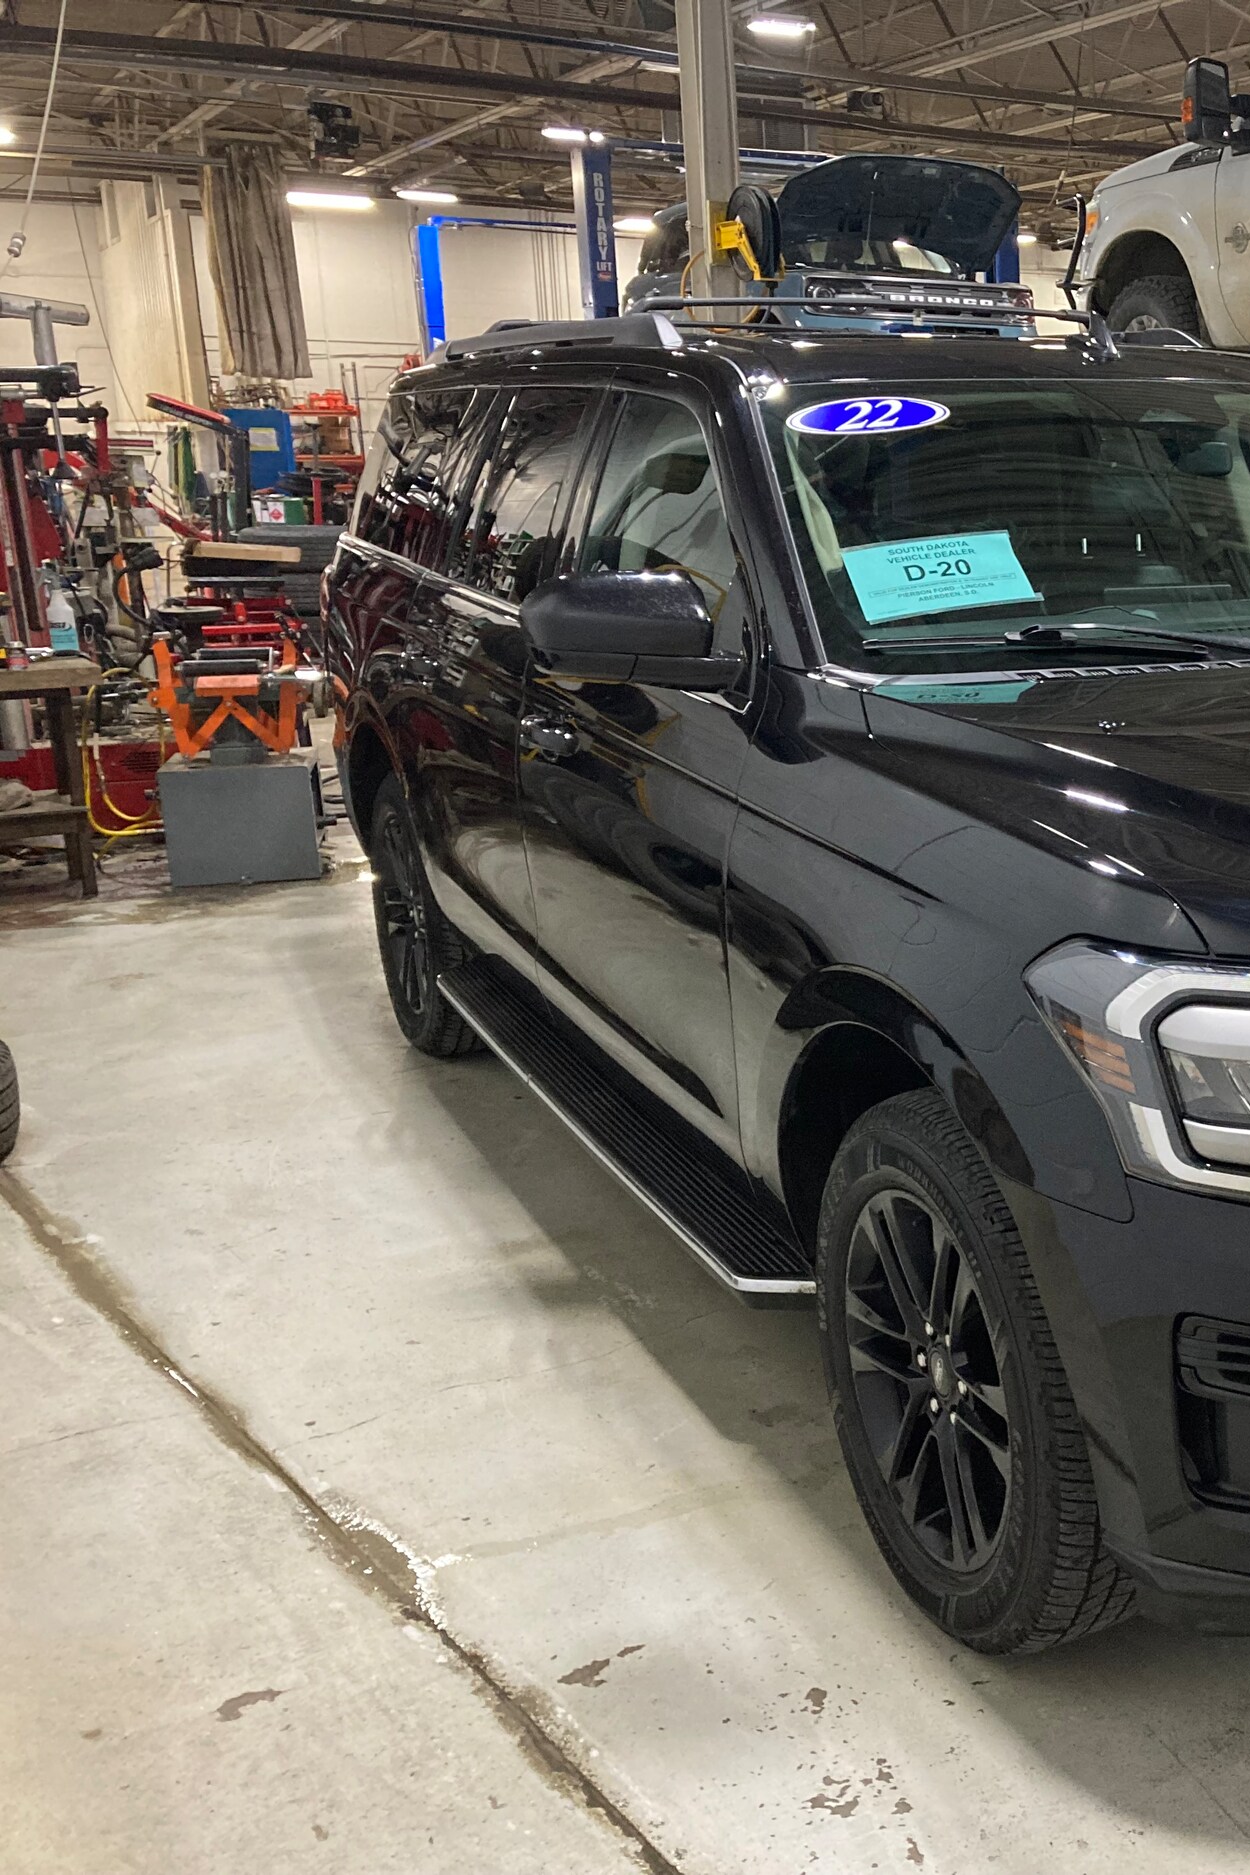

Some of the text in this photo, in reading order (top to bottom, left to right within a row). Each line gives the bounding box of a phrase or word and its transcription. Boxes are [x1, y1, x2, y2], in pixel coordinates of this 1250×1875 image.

[593, 172, 608, 261] ROTARY
[596, 261, 612, 272] LIFT
[889, 294, 994, 307] BRONCO
[834, 399, 904, 432] 22
[887, 548, 975, 564] VEHICLE DEALER
[888, 540, 969, 556] SOUTH DAKOTA
[903, 559, 972, 582] D-20
[897, 589, 932, 598] PIERSON
[933, 585, 955, 594] FORD
[961, 582, 994, 590] LINCOLN
